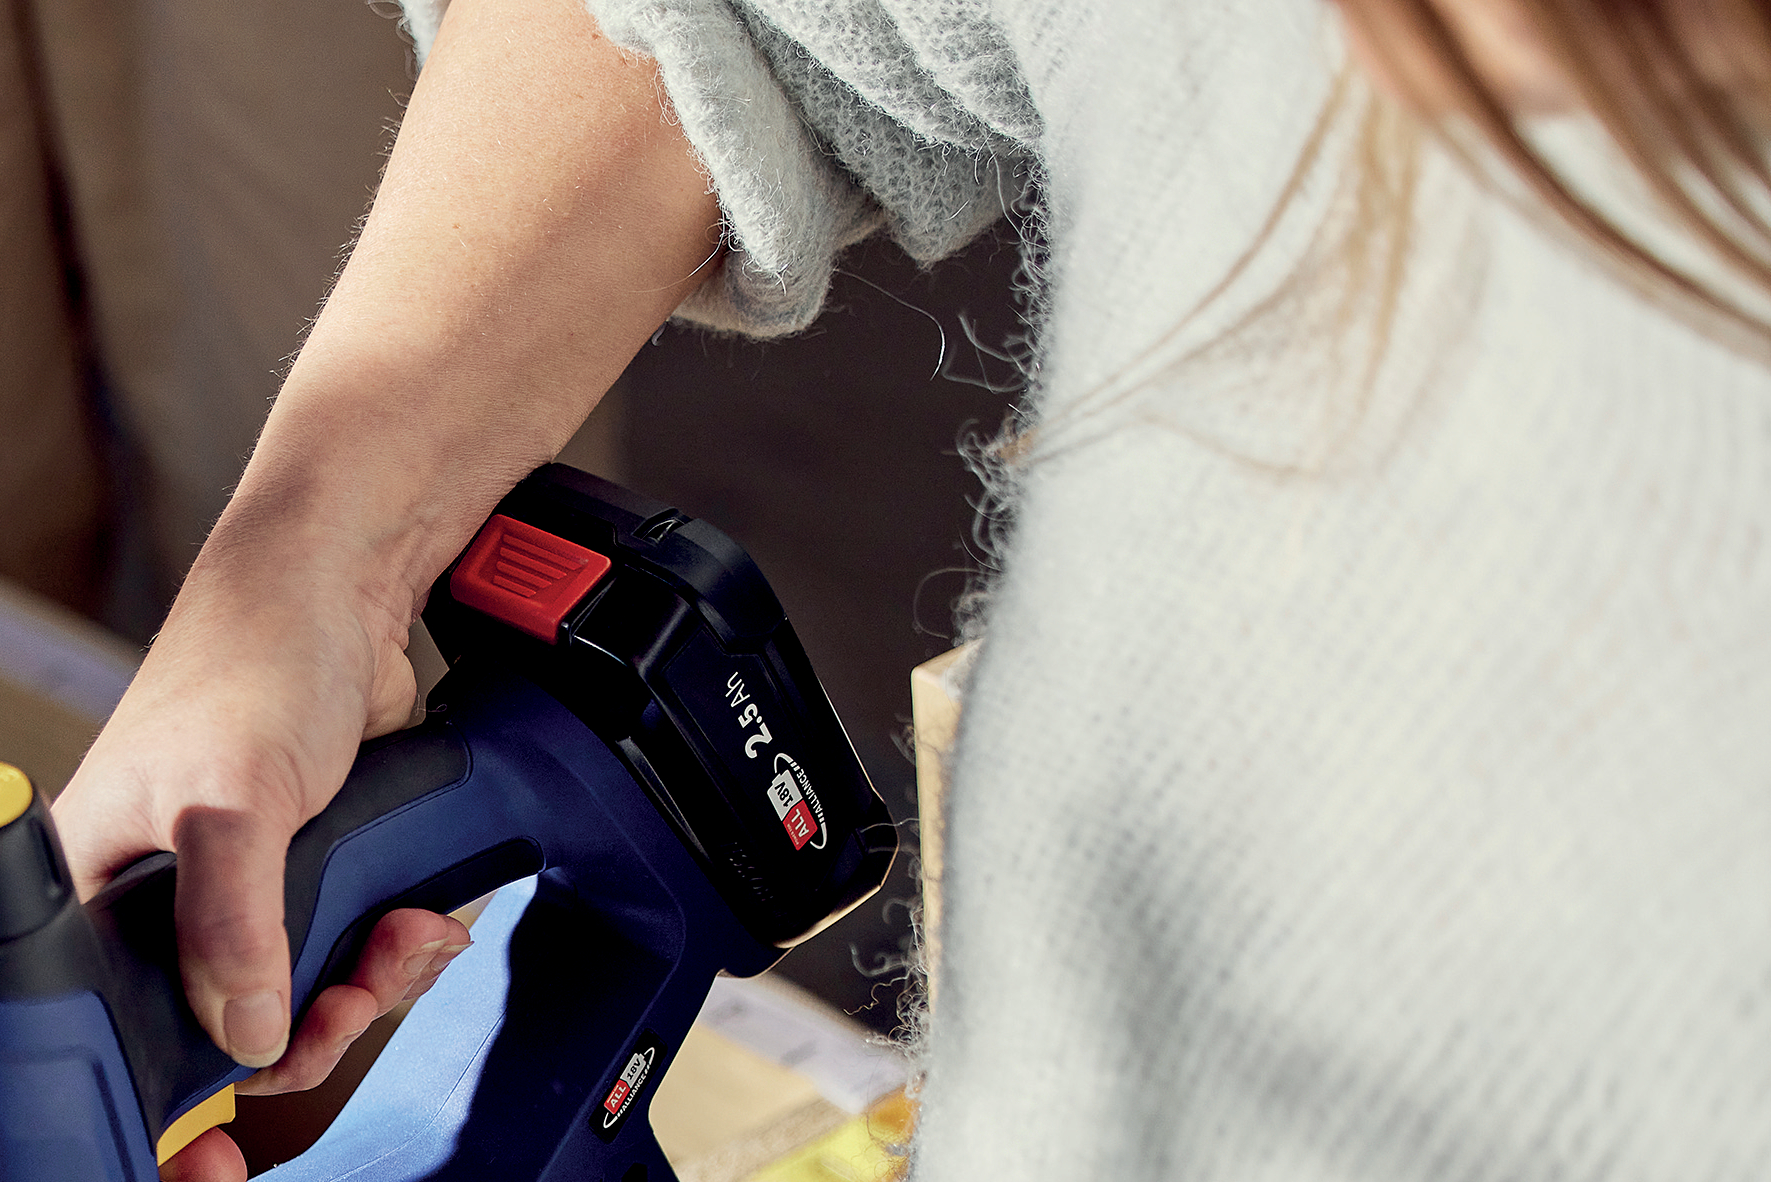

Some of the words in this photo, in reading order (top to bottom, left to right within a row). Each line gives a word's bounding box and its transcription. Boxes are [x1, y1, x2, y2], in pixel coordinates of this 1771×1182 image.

[725, 671, 750, 708] Ah
[737, 703, 773, 759] 2.5
[774, 781, 794, 808] 18V
[796, 768, 823, 817] ALLIANCE
[790, 808, 810, 838] ALL
[610, 1086, 627, 1108] ALL
[626, 1058, 641, 1080] 18V
[622, 1073, 647, 1112] ALLIANCE
